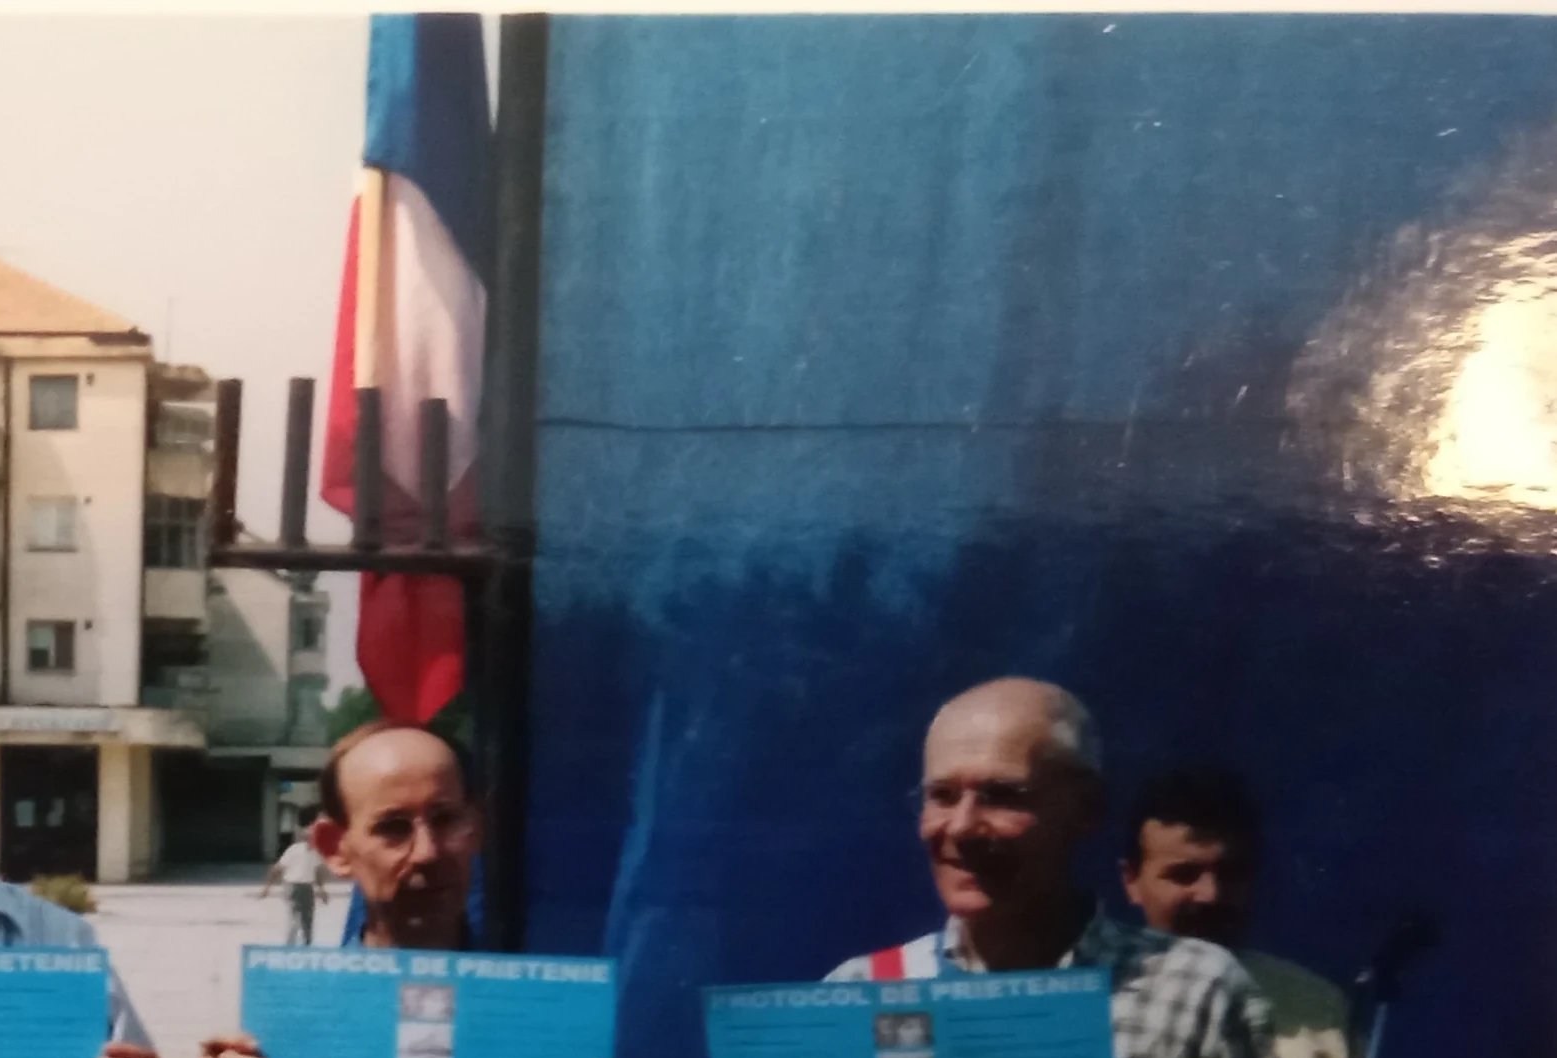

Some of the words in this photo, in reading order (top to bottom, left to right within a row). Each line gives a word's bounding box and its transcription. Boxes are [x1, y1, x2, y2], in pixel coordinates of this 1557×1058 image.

[248, 951, 400, 975] PROTOCOL
[411, 956, 449, 976] DE
[458, 958, 609, 983] PRIETENIE
[712, 986, 870, 1009] PROTOCOL
[880, 983, 921, 1004] DE
[931, 973, 1102, 1002] PRIETENIE
